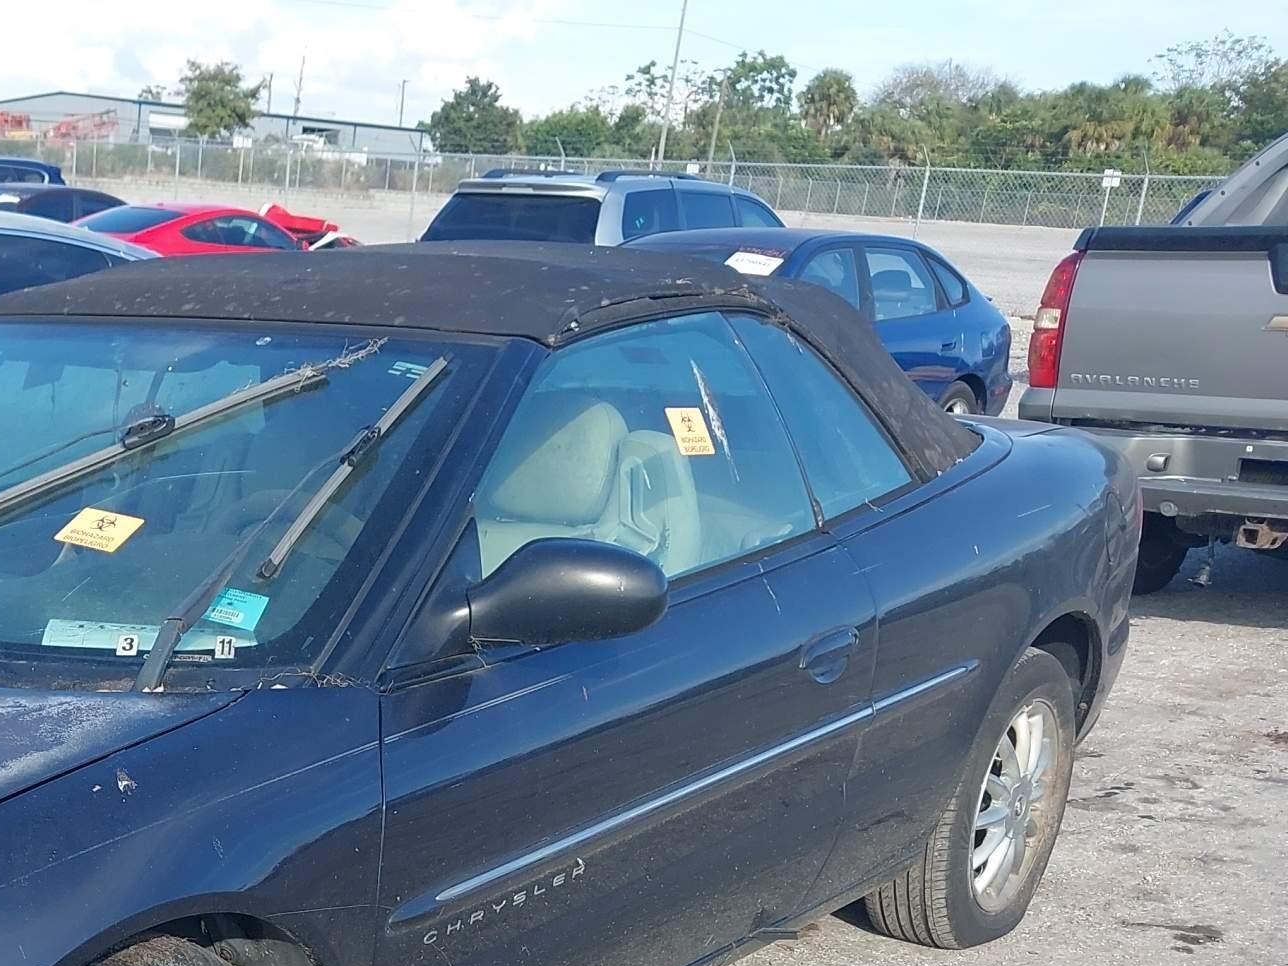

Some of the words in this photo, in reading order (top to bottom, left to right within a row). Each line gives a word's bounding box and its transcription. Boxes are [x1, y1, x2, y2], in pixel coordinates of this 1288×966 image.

[1070, 373, 1200, 389] AVALANCHE
[121, 637, 135, 651] 3
[218, 638, 233, 656] 11
[423, 863, 585, 945] CHRYSLER
